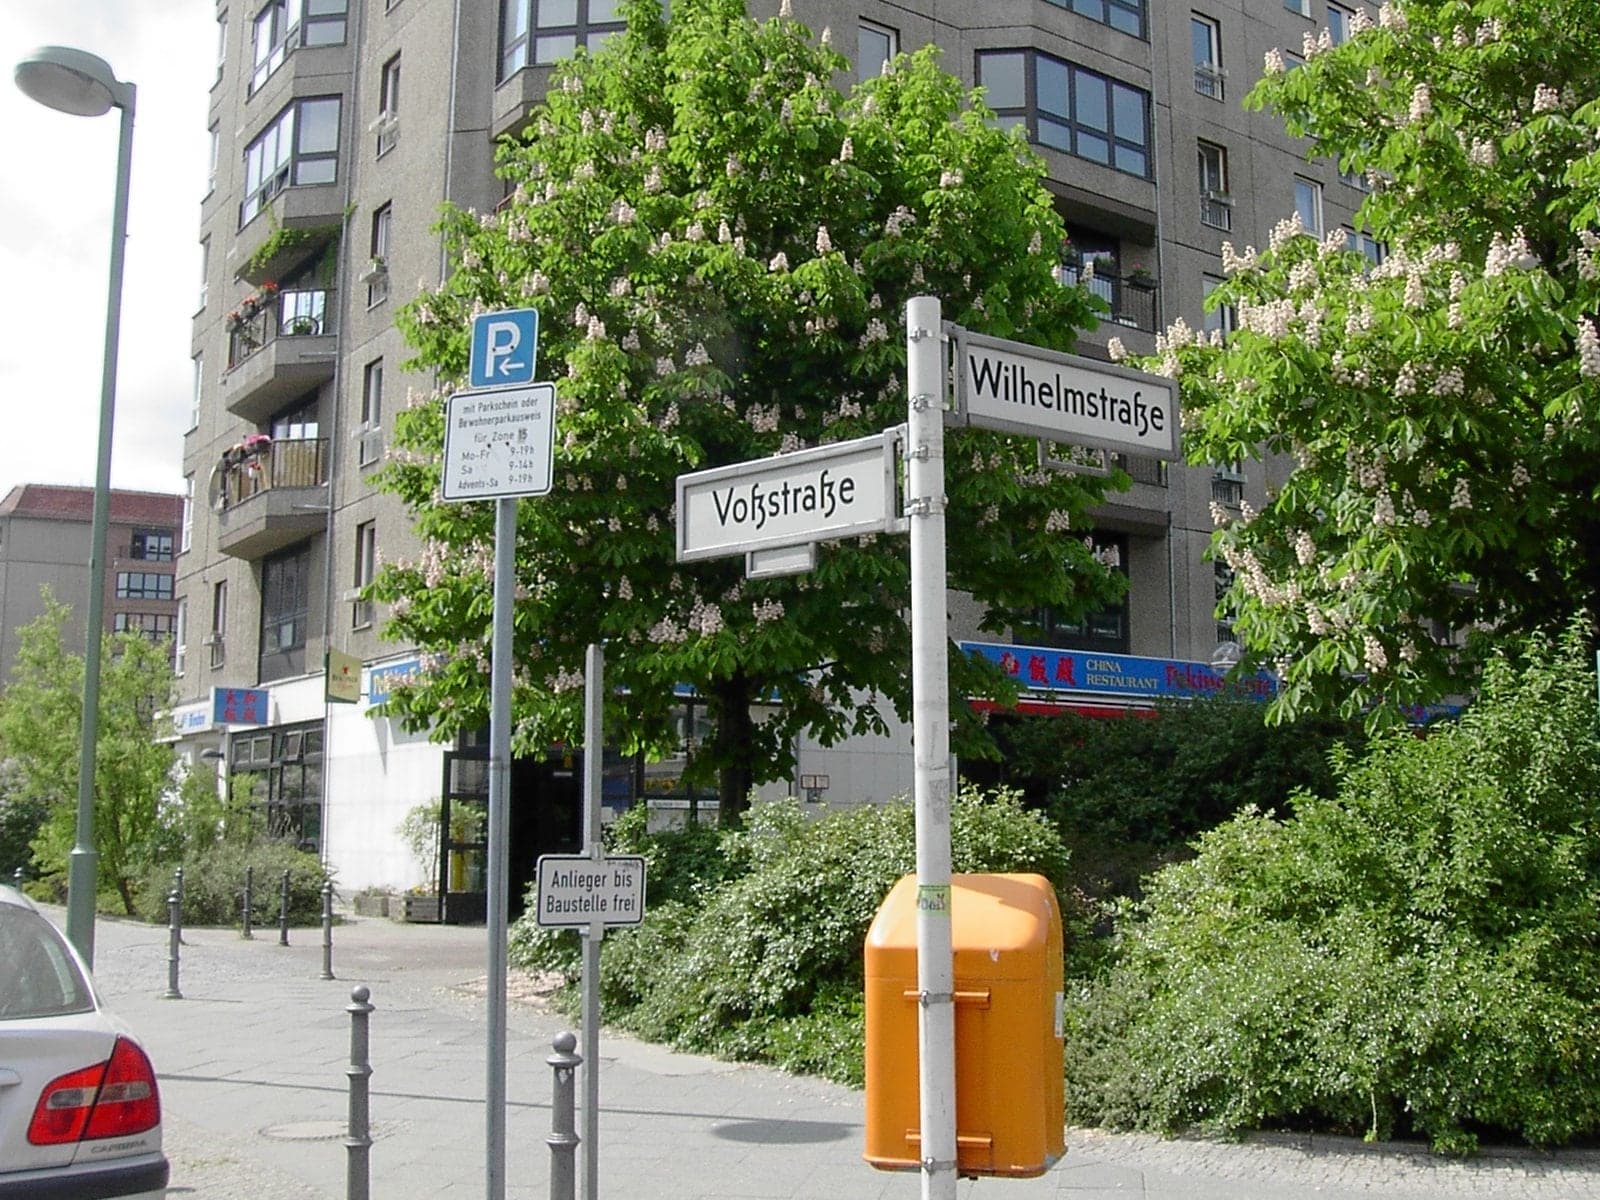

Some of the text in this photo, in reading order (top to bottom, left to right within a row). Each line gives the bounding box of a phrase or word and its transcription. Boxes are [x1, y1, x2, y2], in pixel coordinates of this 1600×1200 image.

[485, 321, 521, 378] P
[969, 354, 1165, 437] Wilhelmstraße
[478, 399, 519, 413] Parkschein
[521, 397, 539, 408] oder
[474, 431, 488, 443] für
[492, 431, 515, 442] Zone
[462, 449, 490, 460] Mo-Fr
[460, 465, 473, 475] Sa
[712, 469, 855, 530] Voßstraße
[1086, 659, 1122, 673] CHINA
[1086, 673, 1159, 689] RESTAURANT
[551, 869, 633, 892] Anlieger bis
[546, 893, 635, 913] Baustelle frei
